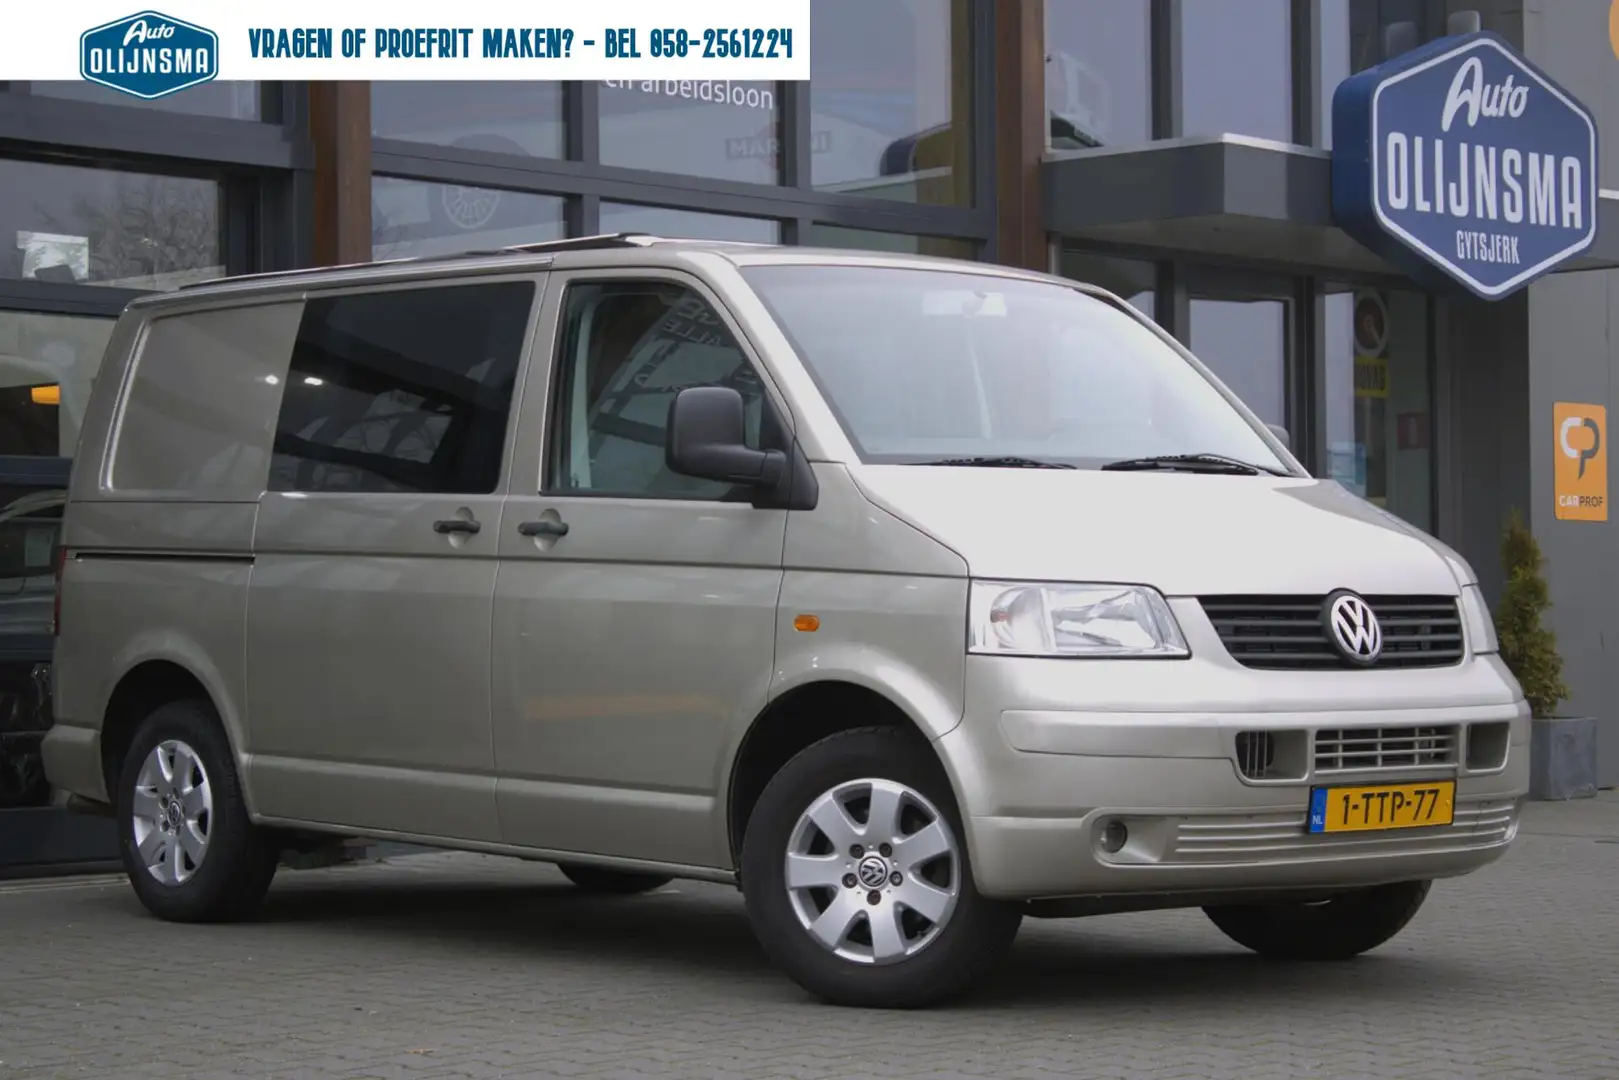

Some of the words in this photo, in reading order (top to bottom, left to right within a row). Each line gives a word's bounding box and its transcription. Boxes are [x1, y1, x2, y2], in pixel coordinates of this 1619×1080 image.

[1441, 57, 1529, 132] Auto
[1387, 132, 1582, 229] OLIJNSMA
[1456, 230, 1520, 264] GYTSJERK
[1312, 815, 1323, 825] NL
[1343, 789, 1440, 825] 1-TTP-77
